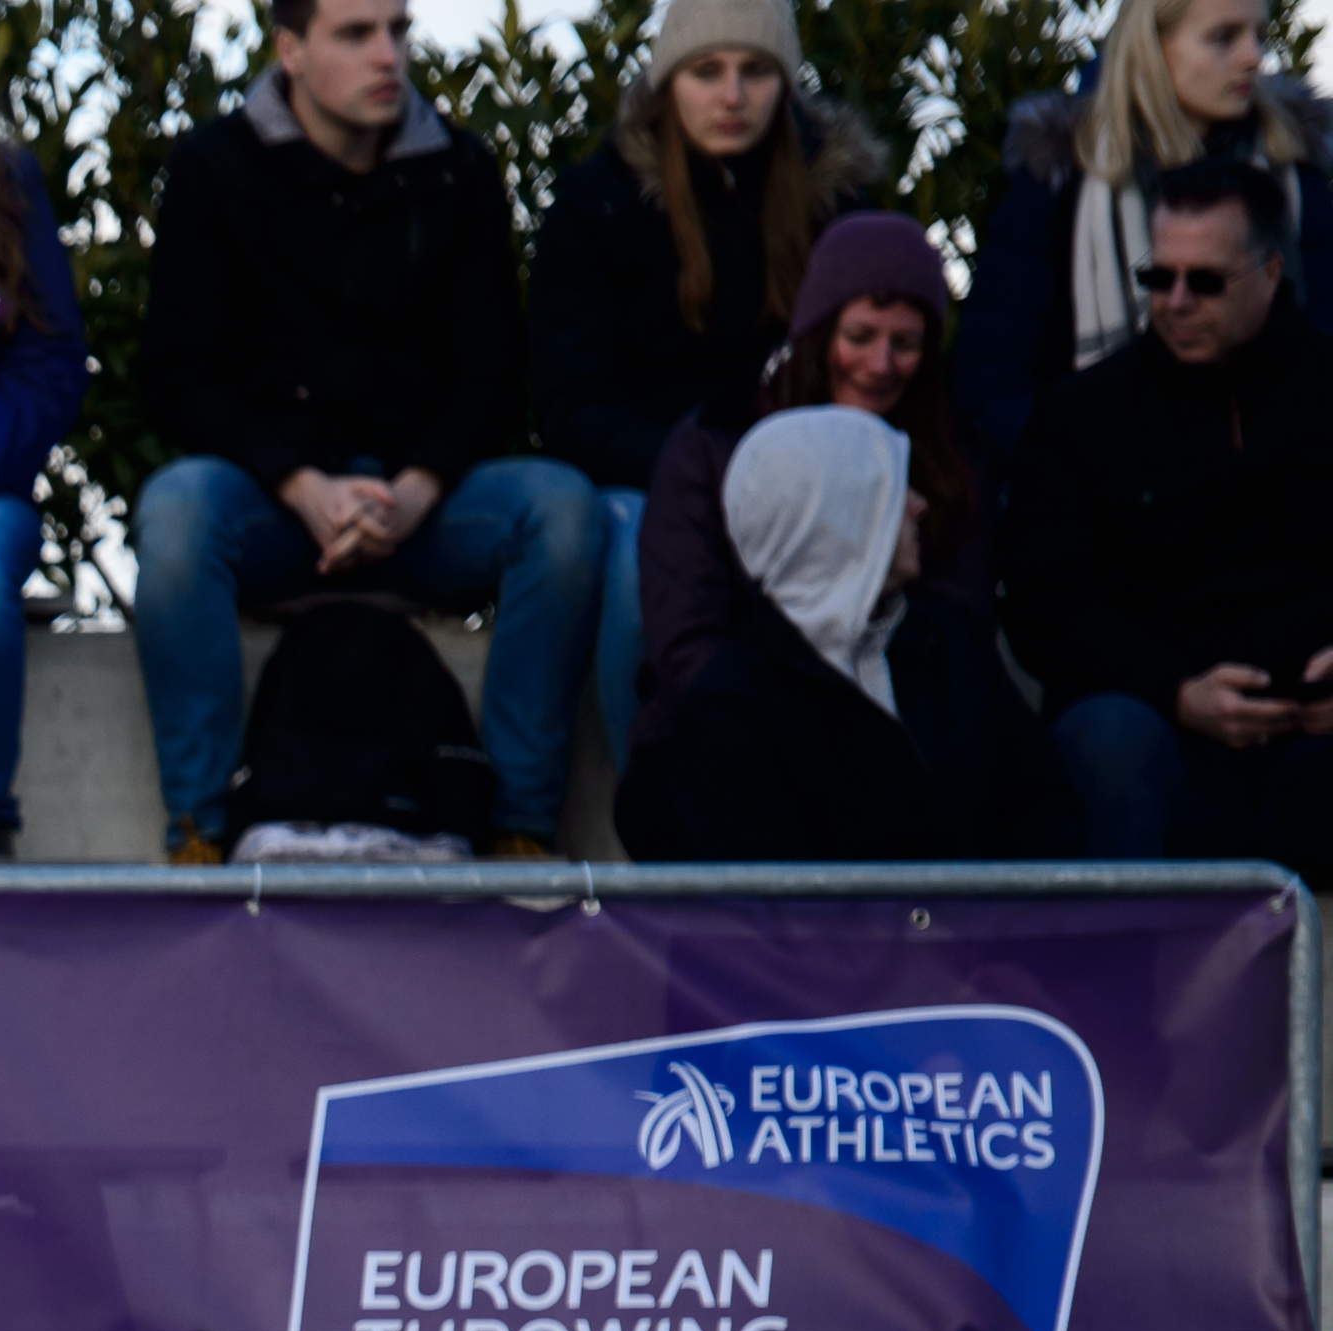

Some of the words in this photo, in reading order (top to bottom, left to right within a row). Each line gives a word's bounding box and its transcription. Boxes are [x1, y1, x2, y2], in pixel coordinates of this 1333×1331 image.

[750, 1065, 1054, 1119] EUROPEAN
[747, 1116, 1055, 1170] ATHLETICS
[360, 1249, 773, 1310] EUROPEAN
